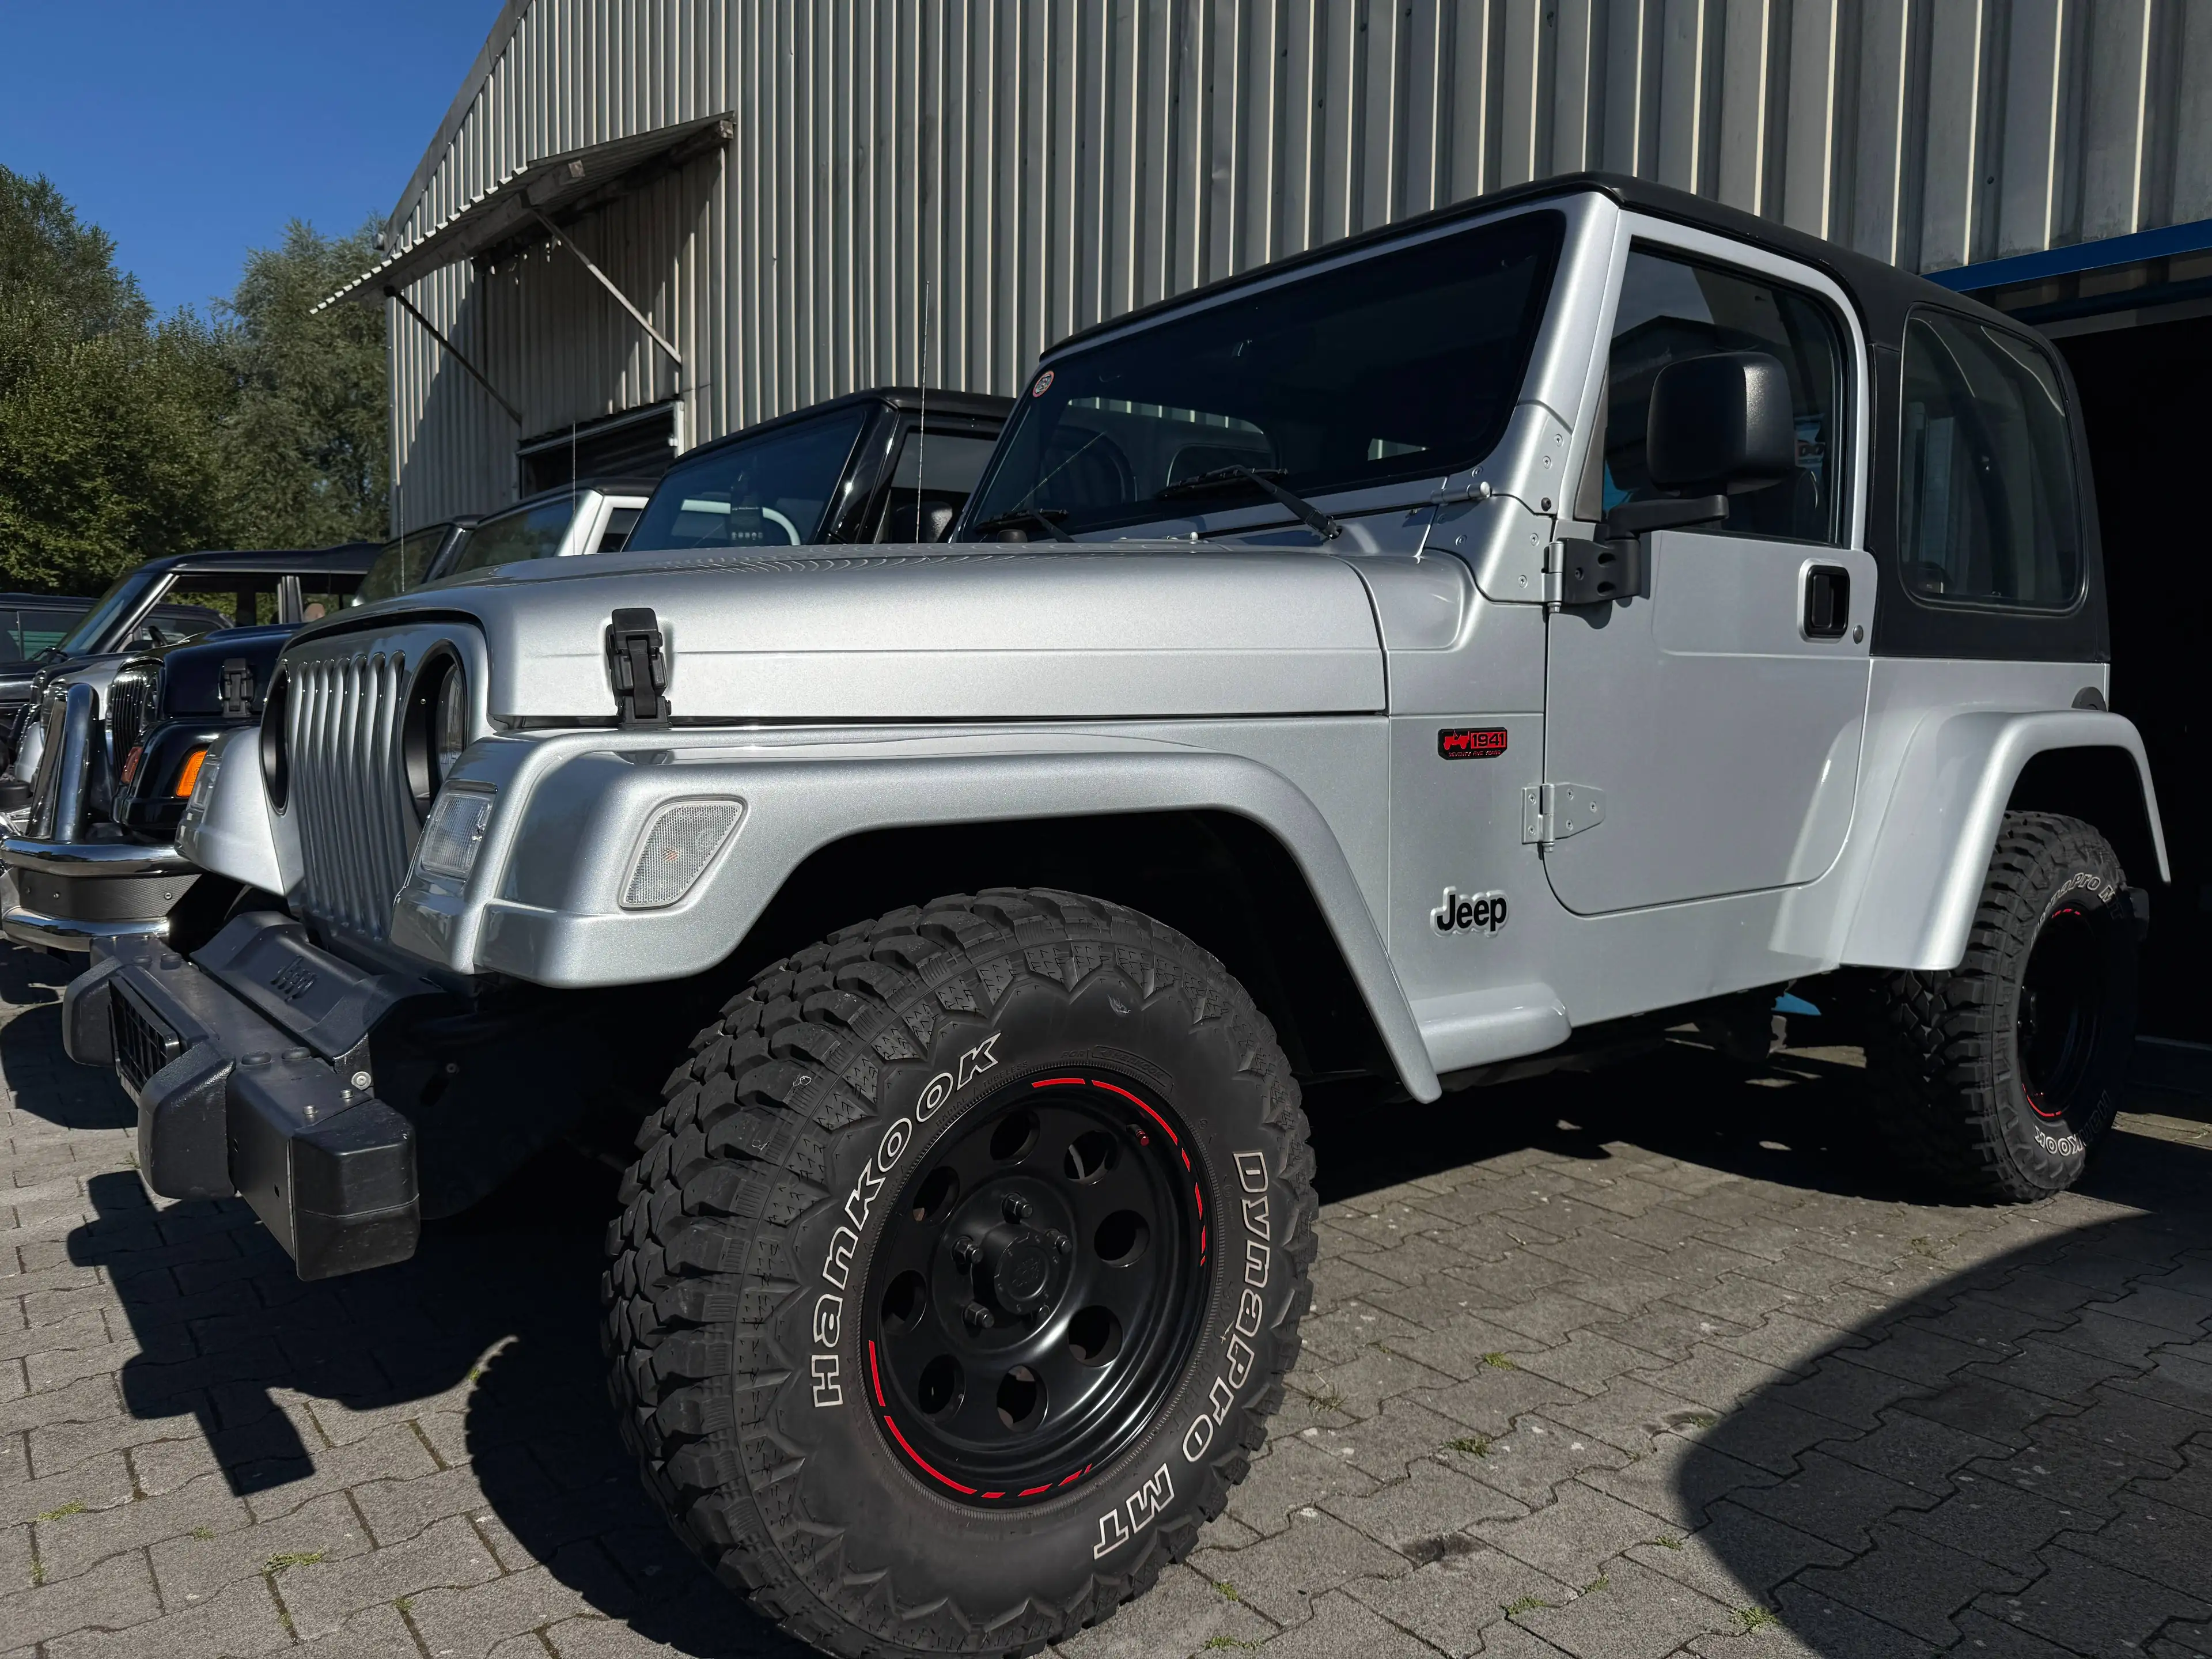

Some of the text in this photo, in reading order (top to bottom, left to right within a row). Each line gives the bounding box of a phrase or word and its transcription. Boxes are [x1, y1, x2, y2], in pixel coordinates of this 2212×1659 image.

[1472, 733, 1504, 747] 1941
[1435, 892, 1508, 933] Jeep
[983, 1059, 1029, 1088] TUBELESS
[935, 1096, 968, 1127] RADIAL
[1093, 1463, 1175, 1560] MT
